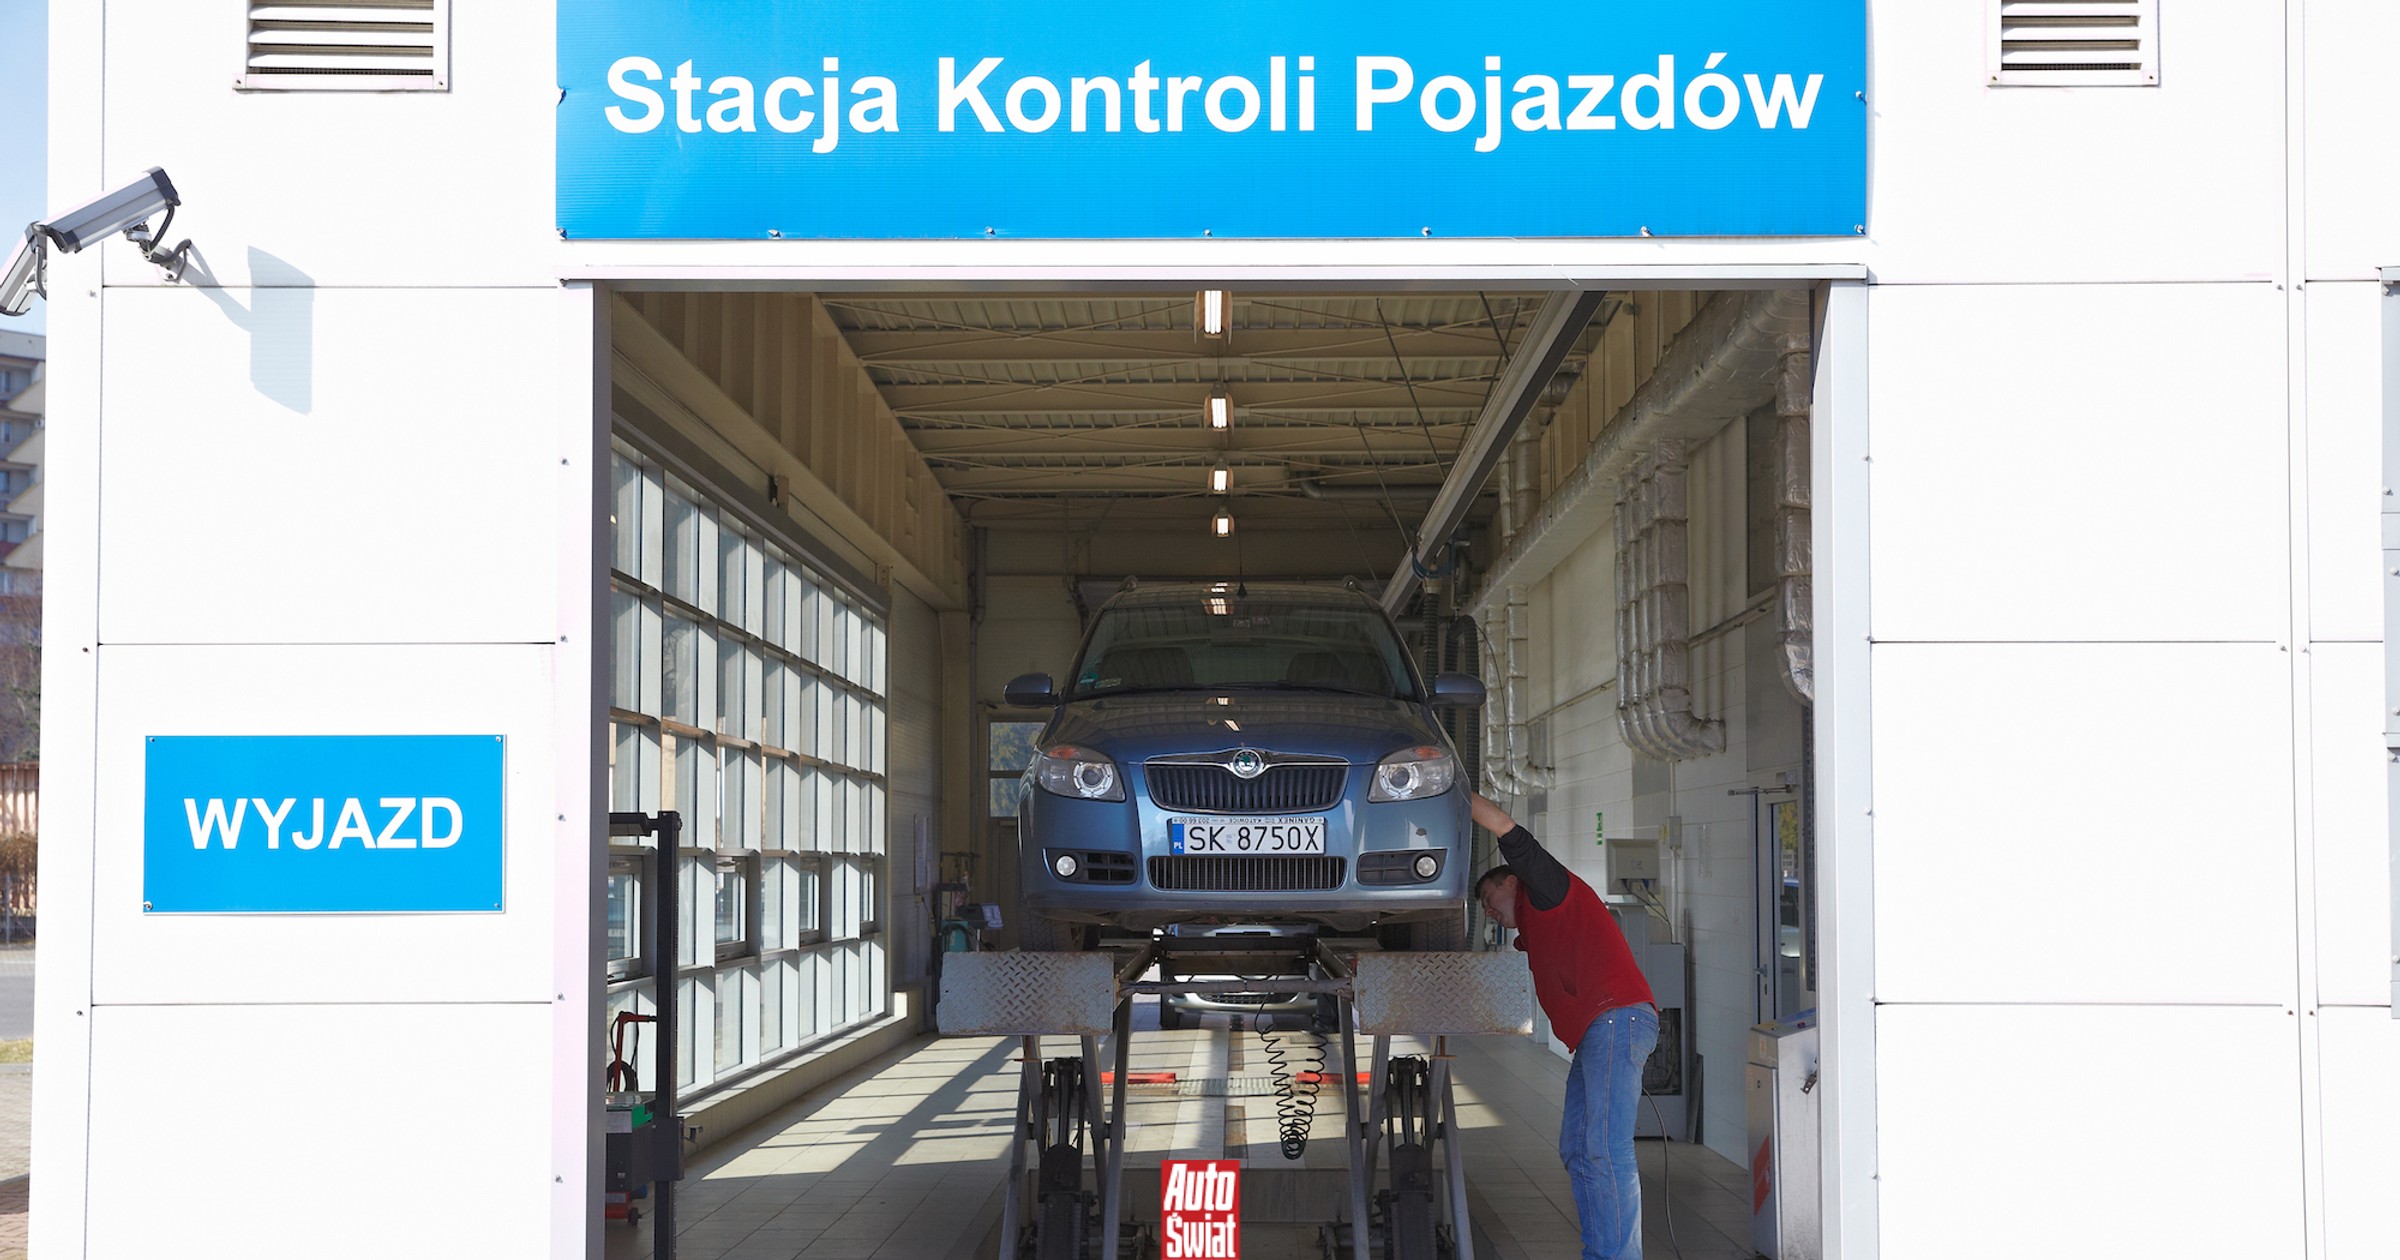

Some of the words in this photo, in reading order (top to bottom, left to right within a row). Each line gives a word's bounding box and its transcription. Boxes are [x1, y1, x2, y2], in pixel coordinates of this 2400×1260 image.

[604, 56, 899, 153] Stacja
[937, 55, 1315, 133] Kontroli
[1357, 52, 1825, 152] Pojazdów
[183, 797, 463, 851] WYJAZD
[1189, 826, 1225, 851] SK
[1238, 826, 1319, 851] 8750X
